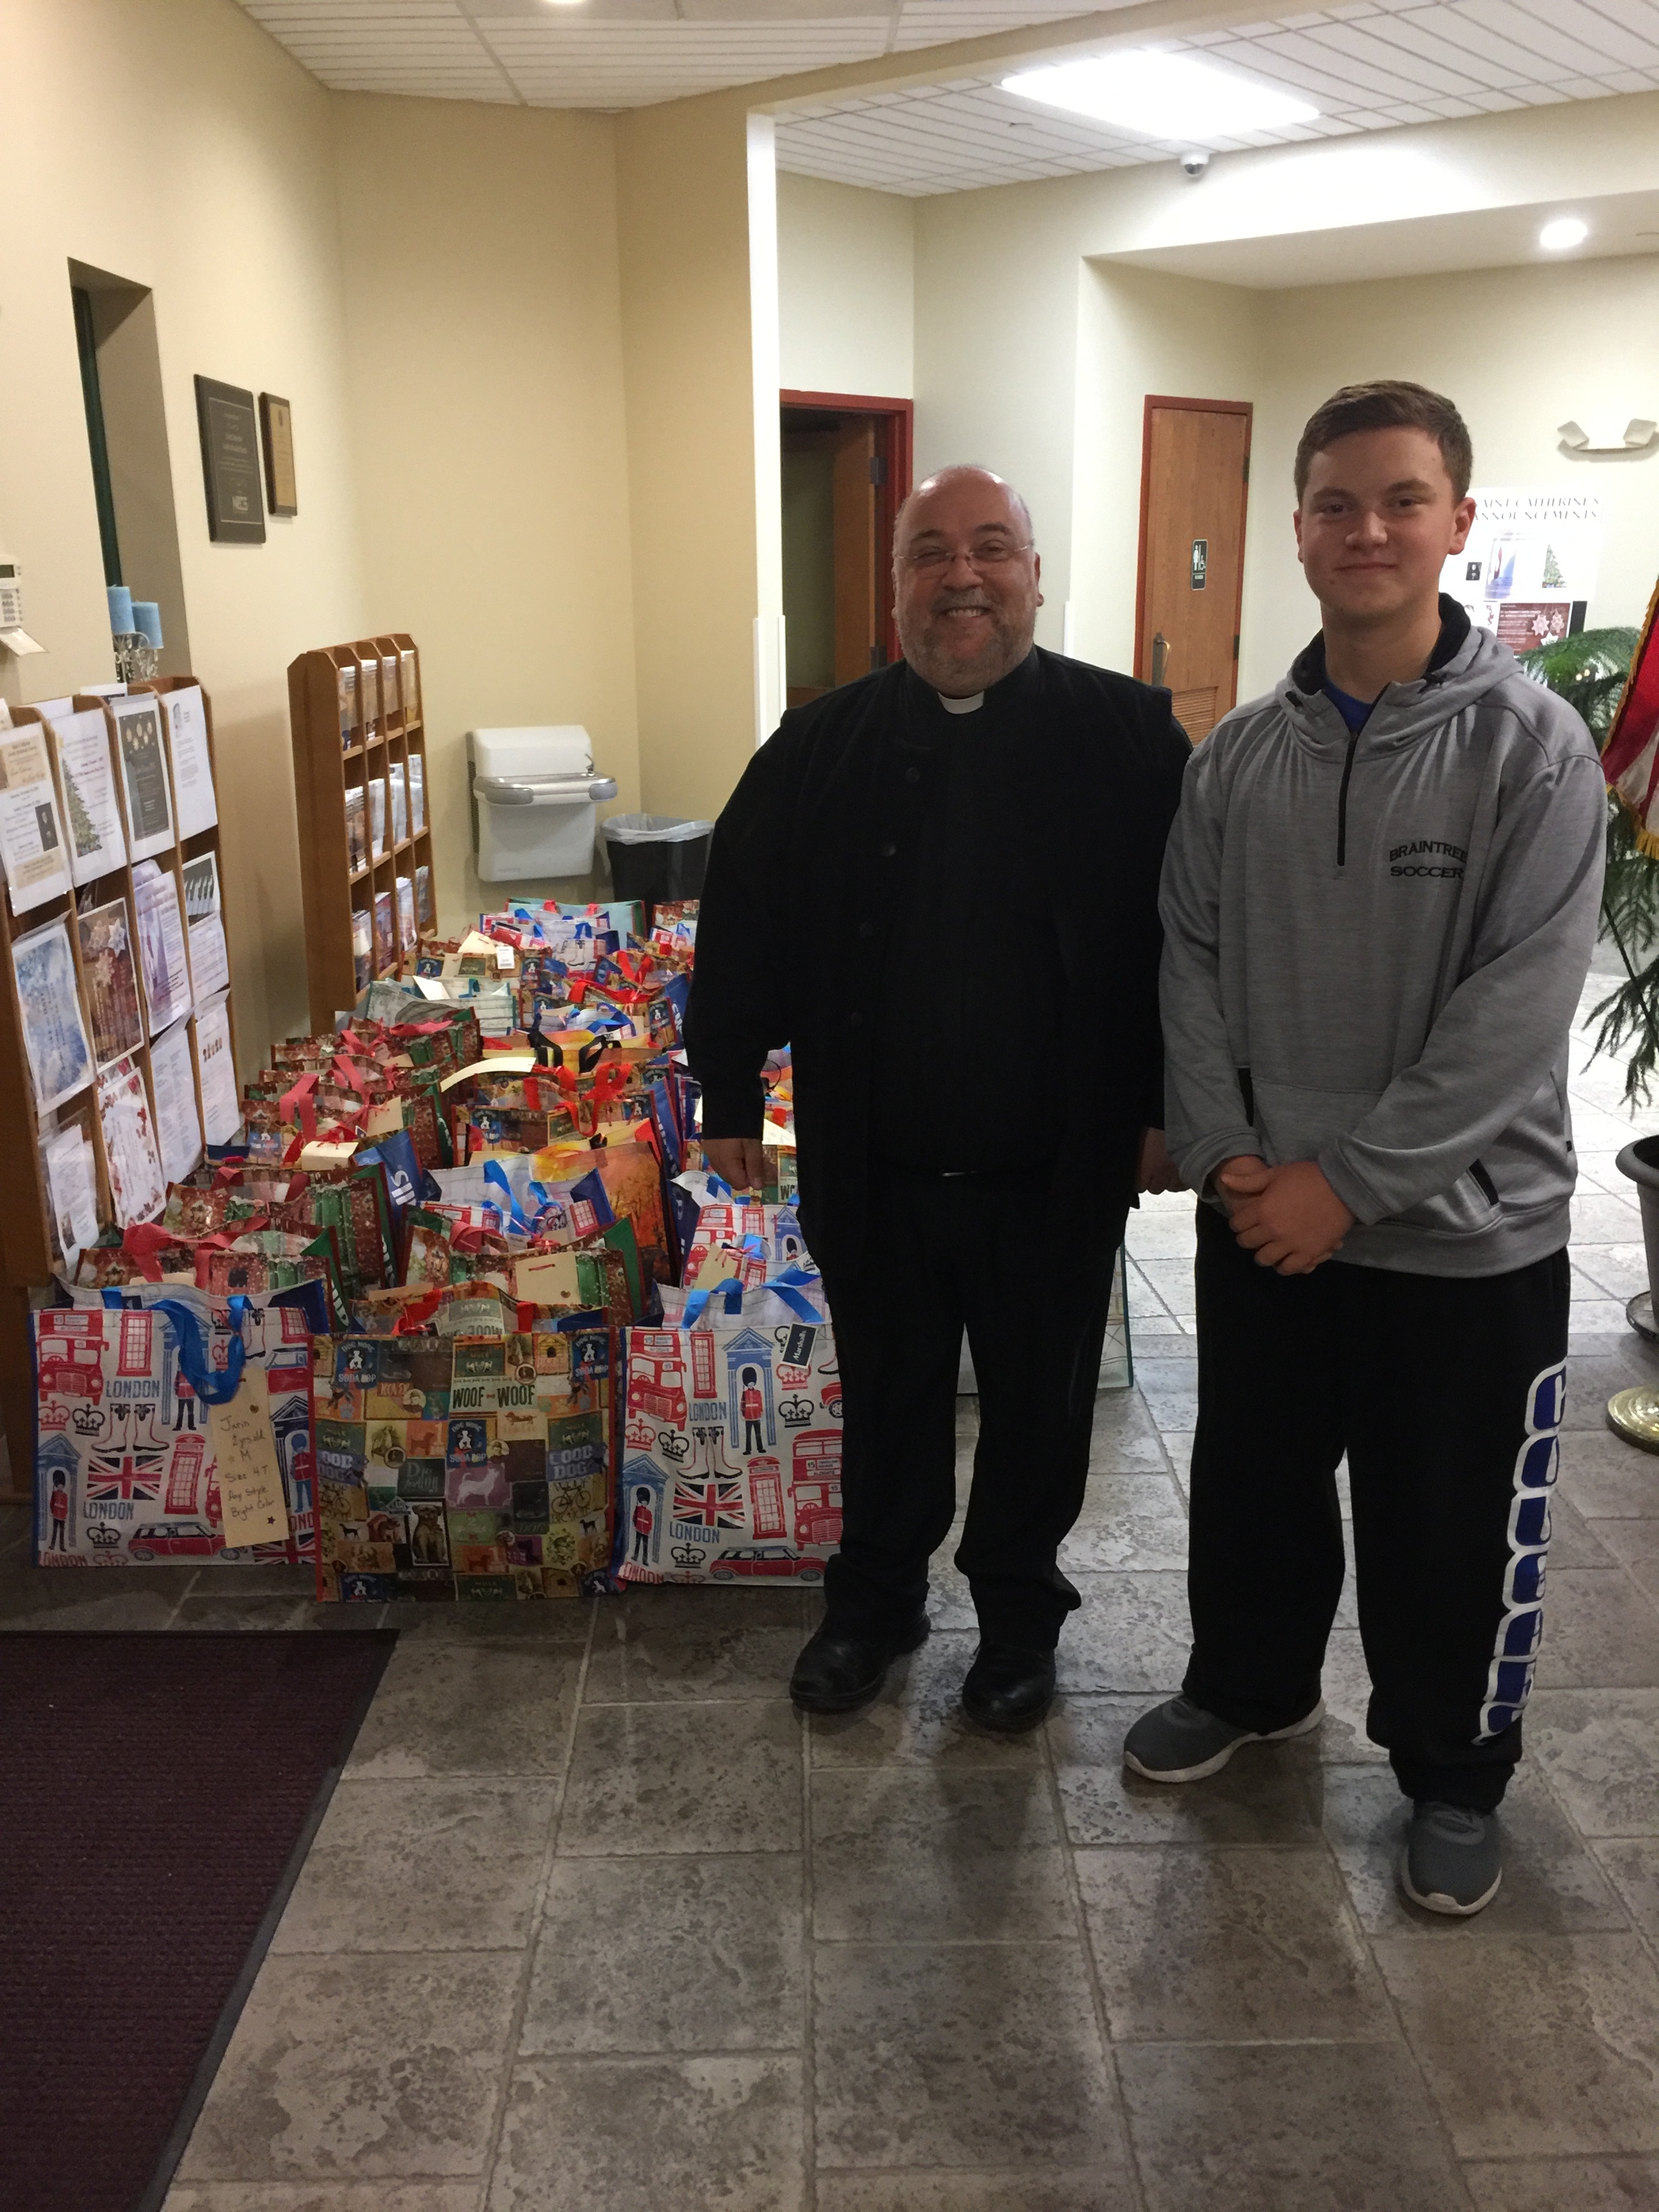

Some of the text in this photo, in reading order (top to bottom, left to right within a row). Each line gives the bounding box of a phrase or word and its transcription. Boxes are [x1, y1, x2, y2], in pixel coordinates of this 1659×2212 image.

[1389, 840, 1467, 865] BRAINTREE
[1390, 865, 1465, 880] SOCCER
[793, 1330, 807, 1361] Marshalls
[338, 1373, 360, 1383] SODA
[105, 1380, 160, 1397] LONDON
[453, 1384, 535, 1409] WOOF WOOF
[689, 1401, 726, 1422] LONDON
[240, 1449, 251, 1462] M
[83, 1501, 134, 1520] LONDON
[669, 1521, 720, 1544] LONDON
